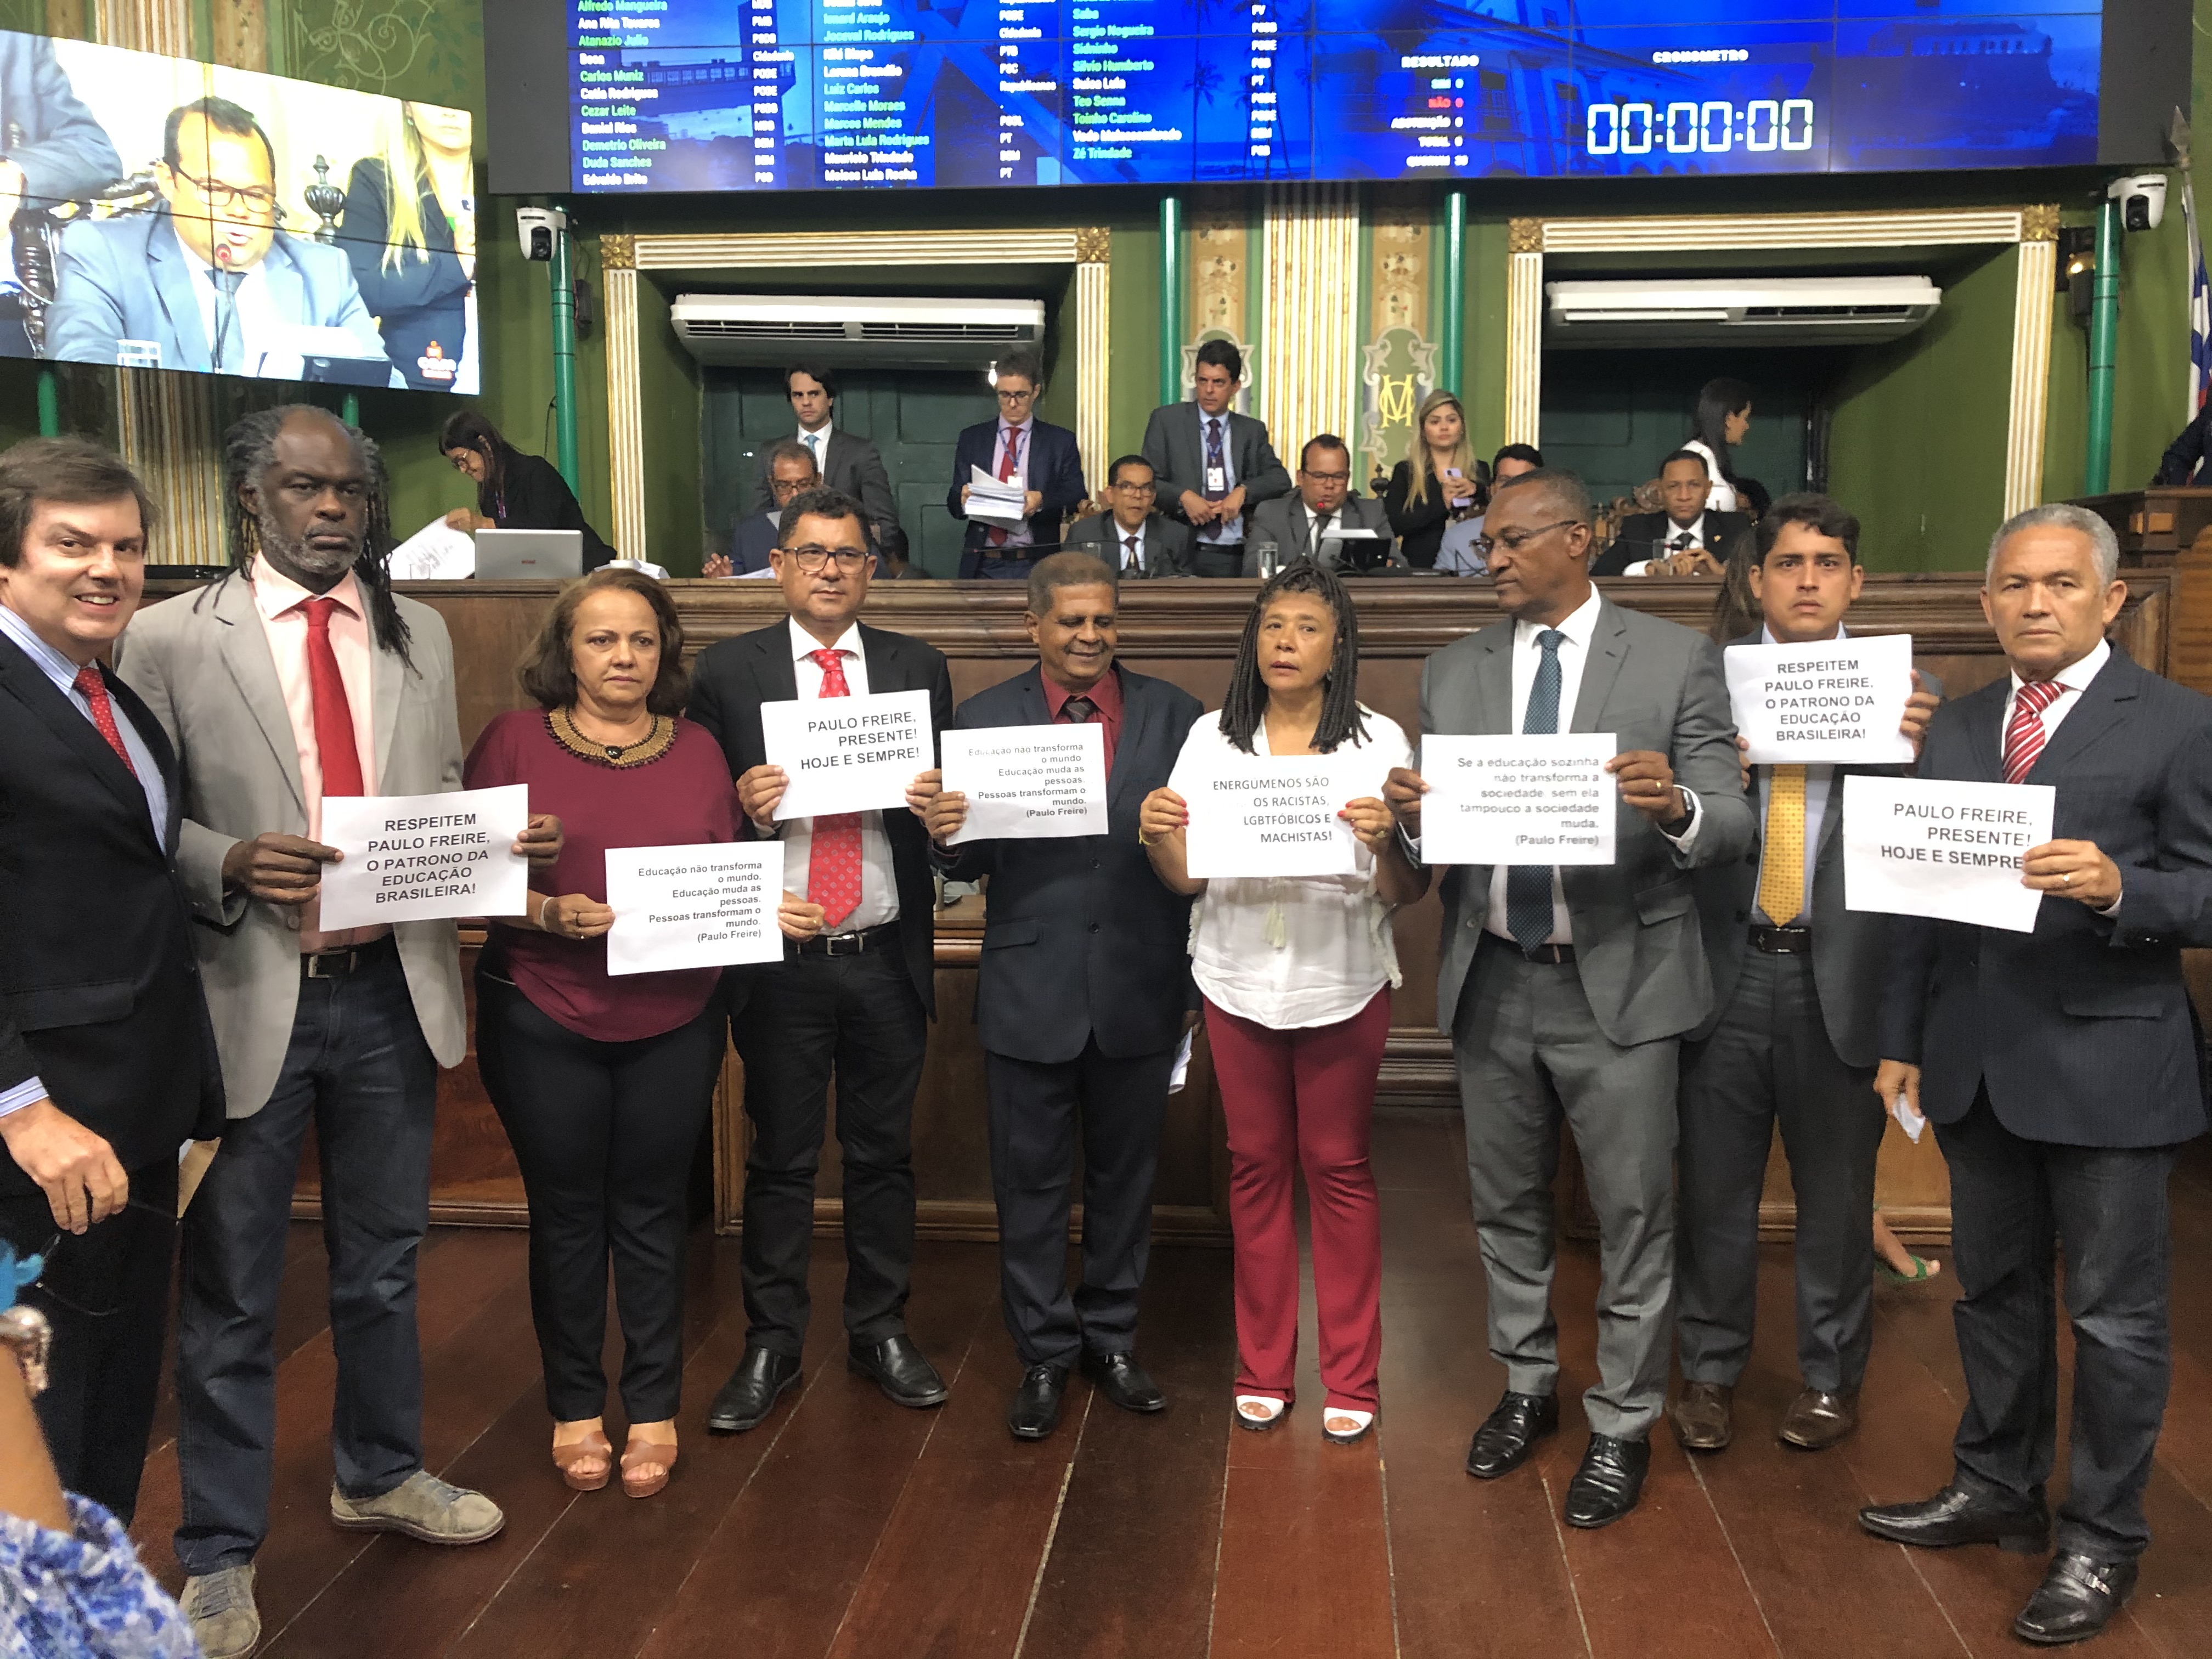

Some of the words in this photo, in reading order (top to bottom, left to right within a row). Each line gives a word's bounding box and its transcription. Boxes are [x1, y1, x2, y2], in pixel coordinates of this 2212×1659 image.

[578, 0, 613, 11] Alfredo
[616, 0, 667, 13] Mangueira
[579, 35, 622, 46] Atanazio
[864, 29, 914, 42] Rodrigues
[580, 70, 612, 82] Carlos
[614, 70, 644, 81] Muniz
[754, 68, 777, 78] PODE
[754, 86, 777, 96] PODE
[824, 83, 845, 95] Luiz
[847, 82, 879, 94] Carlos
[824, 100, 867, 112] Marcelle
[868, 100, 905, 111] Moraes
[1073, 96, 1092, 106] Teo
[582, 105, 610, 116] Cezar
[612, 105, 636, 116] Leite
[824, 118, 861, 129] Marcos
[863, 117, 902, 128] Mendes
[1587, 99, 1813, 154] 00:00:00
[583, 139, 627, 151] Demetrio
[629, 138, 666, 150] Oliveira
[825, 136, 854, 146] Marta
[879, 134, 929, 148] Rodrigues
[1073, 148, 1086, 159] Zé
[583, 156, 608, 168] Duda
[610, 156, 652, 168] Sanches
[1778, 660, 1858, 674] RESPEITEM
[1765, 680, 1813, 692] PAULO
[1765, 699, 1776, 709] O
[1780, 696, 1849, 708] PATRONO
[1855, 696, 1874, 706] DA
[808, 718, 857, 732] PAULO
[862, 712, 916, 727] FREIRE,
[1781, 710, 1860, 725] EDUCAÇÃO
[839, 729, 917, 747] PRESENTE!
[1776, 729, 1865, 741] BRASILEIRA!
[1034, 744, 1083, 752] transforma
[801, 756, 839, 770] HOJE
[844, 754, 853, 765] E
[857, 747, 919, 764] SEMPRE!
[1458, 758, 1472, 767] Se
[1487, 758, 1547, 768] educação
[1551, 758, 1599, 766] sozinha
[999, 767, 1043, 776] Educação
[1521, 773, 1588, 782] transforma
[1306, 776, 1329, 787] SÃO
[1020, 788, 1077, 797] transformam
[1582, 789, 1599, 797] ela
[1254, 798, 1268, 806] OS
[1272, 796, 1329, 806] RACISTAS,
[1026, 809, 1055, 818] (Paulo
[1058, 807, 1087, 815] Freire)
[1460, 804, 1521, 813] tampouco
[1536, 804, 1599, 812] sociedade
[1244, 813, 1321, 825] LGBTFÓBICOS
[1324, 814, 1331, 823] E
[1894, 804, 1954, 819] PAULO
[1961, 808, 2032, 826] FREIRE,
[385, 814, 476, 831] RESPEITEM
[1561, 819, 1599, 828] muda.
[368, 838, 425, 852] PAULO
[430, 832, 490, 847] FREIRE,
[1261, 831, 1331, 843] MACHISTAS!
[1516, 835, 1555, 846] (Paulo
[1559, 835, 1599, 846] Freire)
[1928, 827, 2031, 846] PRESENTE!
[1881, 845, 1927, 861] HOJE
[1932, 849, 1944, 863] E
[367, 860, 379, 871] O
[384, 853, 463, 870] PATRONO
[467, 850, 488, 861] DA
[639, 866, 687, 876] Educação
[710, 862, 761, 872] transforma
[382, 866, 472, 886] EDUCAÇÃO
[727, 873, 761, 882] mundo.
[376, 883, 476, 904] BRASILEIRA!
[673, 888, 719, 898] Educação
[723, 885, 748, 894] muda
[720, 897, 760, 907] pessoas.
[650, 914, 690, 923] Pessoas
[693, 909, 752, 919] transformam
[726, 918, 760, 927] mundo.
[697, 932, 727, 943] (Paulo
[731, 929, 761, 938] Freire)
